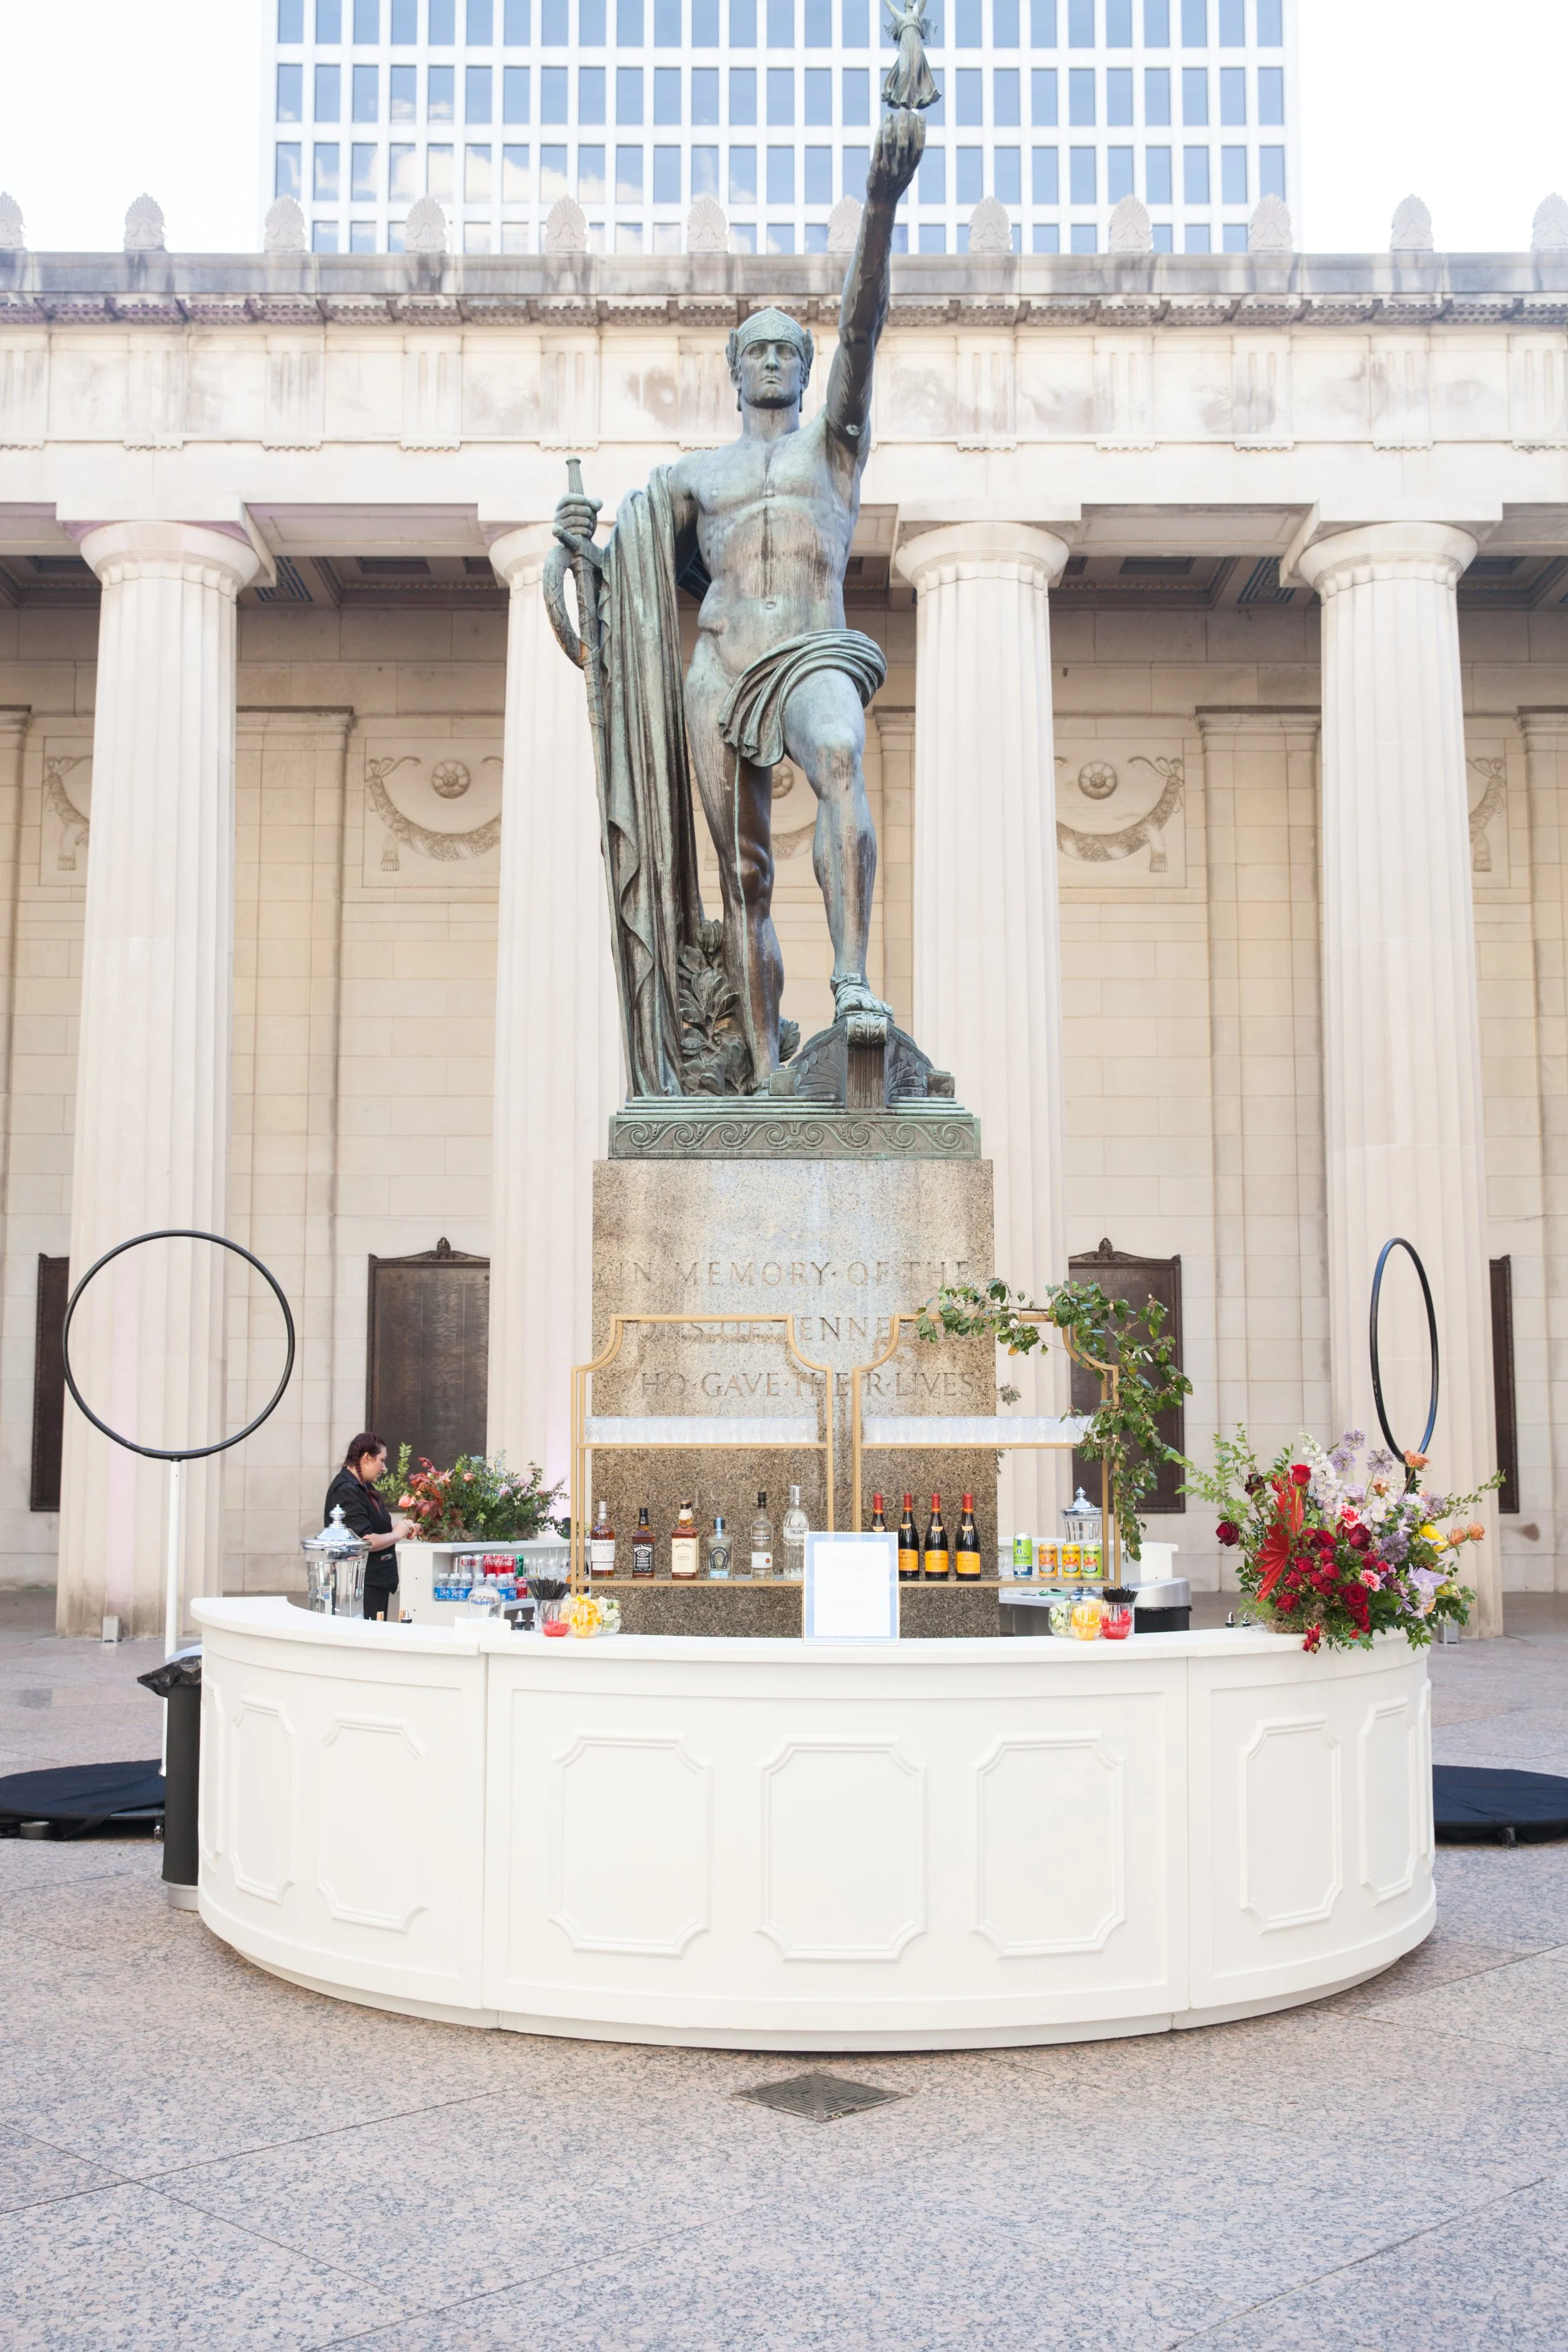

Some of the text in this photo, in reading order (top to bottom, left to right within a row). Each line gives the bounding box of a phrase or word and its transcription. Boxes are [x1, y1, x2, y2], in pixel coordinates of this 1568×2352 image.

[618, 1261, 970, 1286] IN MEMORY OF THE
[611, 1372, 975, 1397] WHO GAVE THER LIVES
